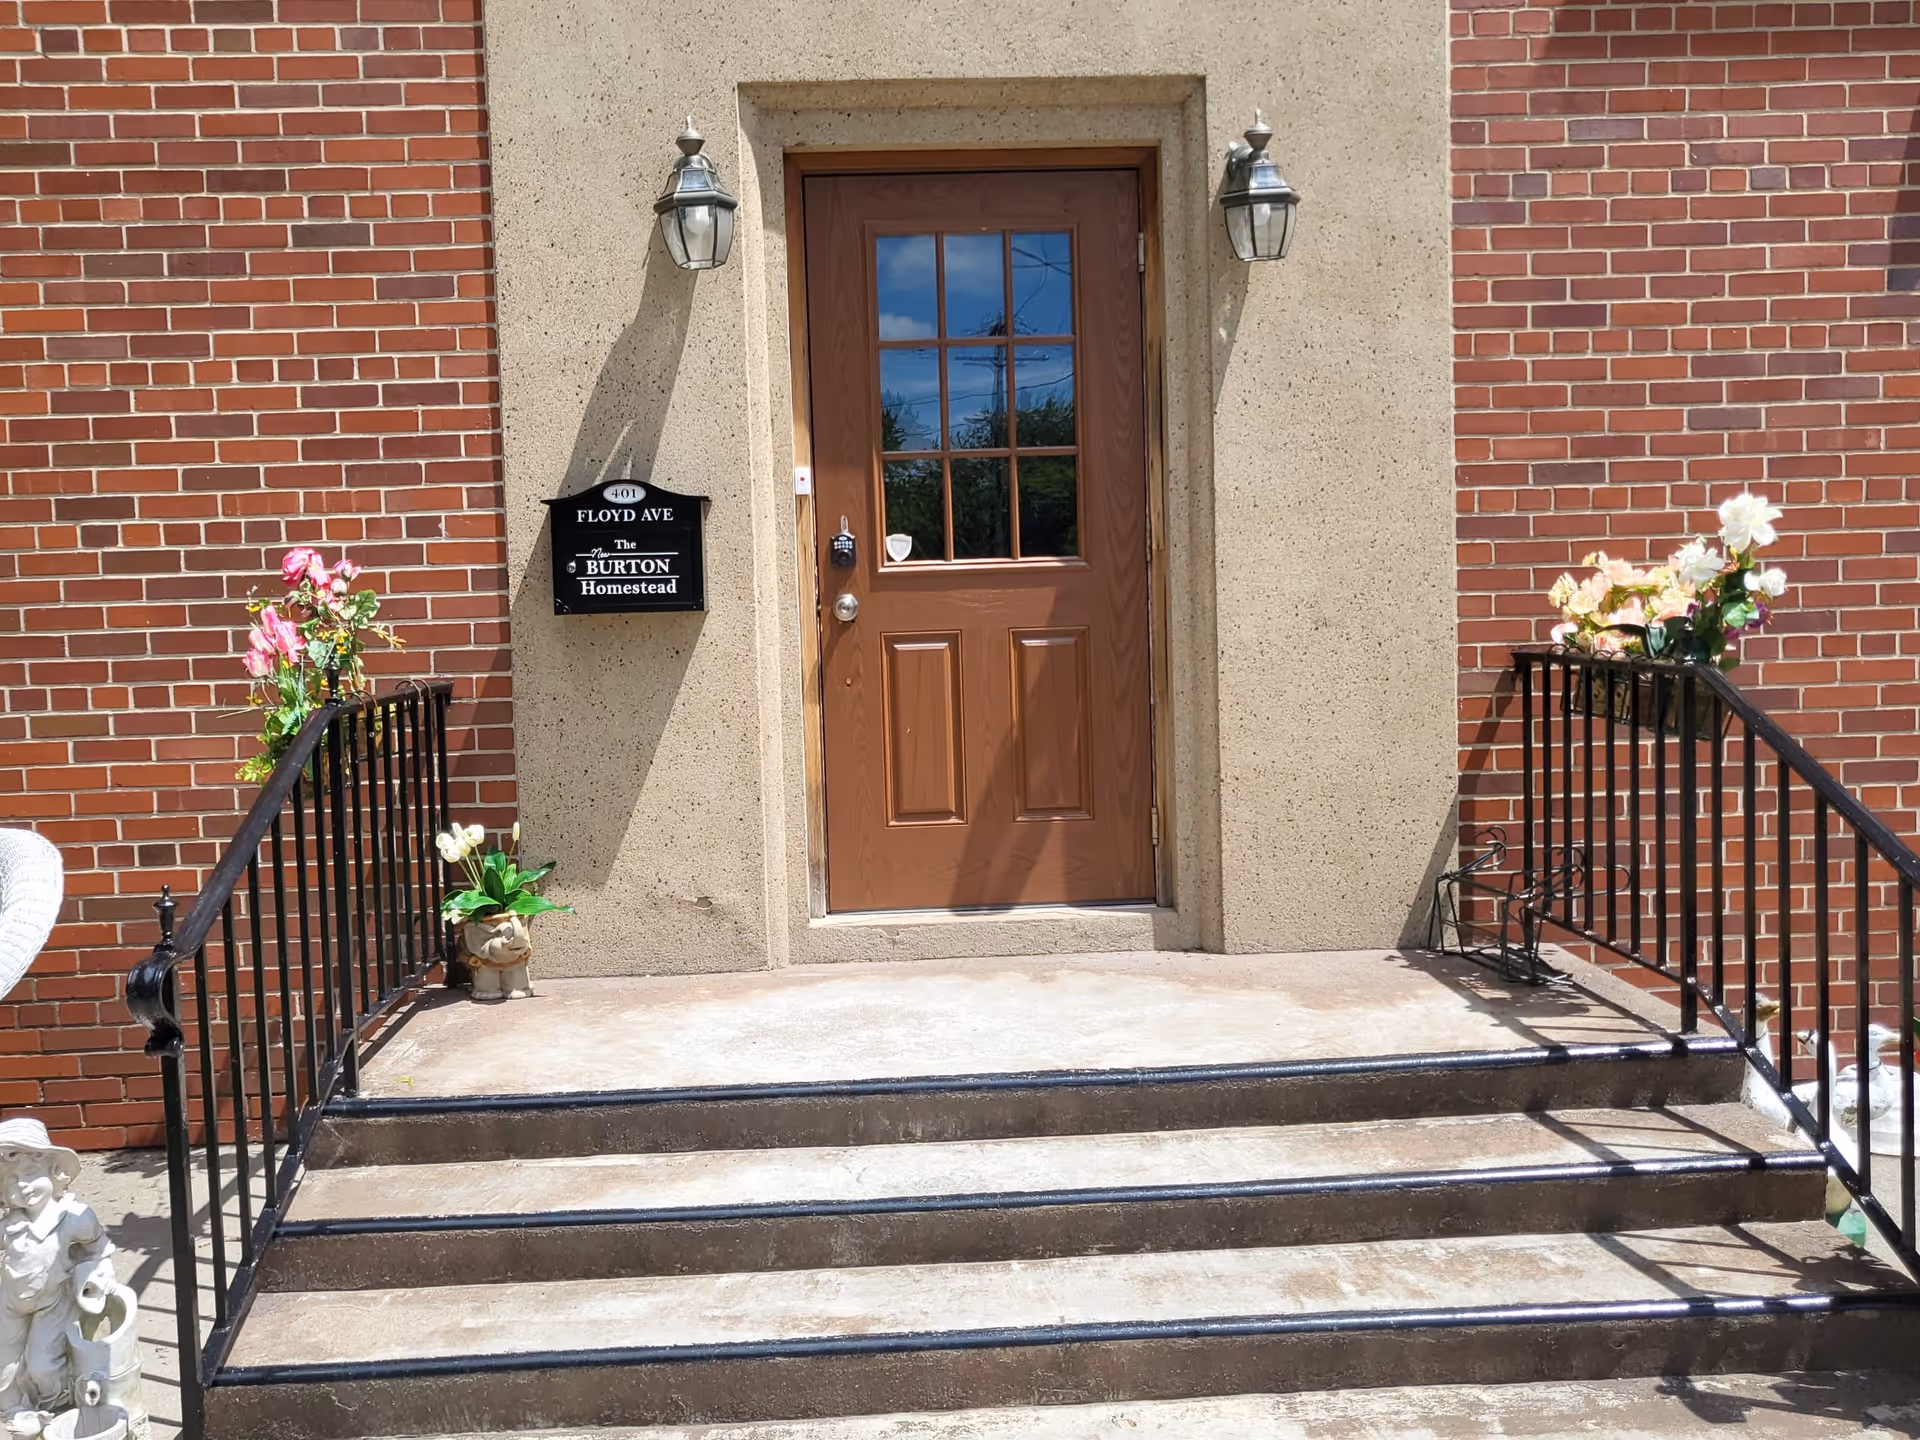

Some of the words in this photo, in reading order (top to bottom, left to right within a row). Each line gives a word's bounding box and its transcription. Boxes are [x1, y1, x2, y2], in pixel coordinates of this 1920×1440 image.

[611, 488, 637, 499] 401
[576, 509, 636, 523] FLOYD
[641, 508, 674, 522] AVE
[614, 539, 637, 550] The
[586, 559, 671, 575] BURTON
[580, 579, 677, 596] Homestead
